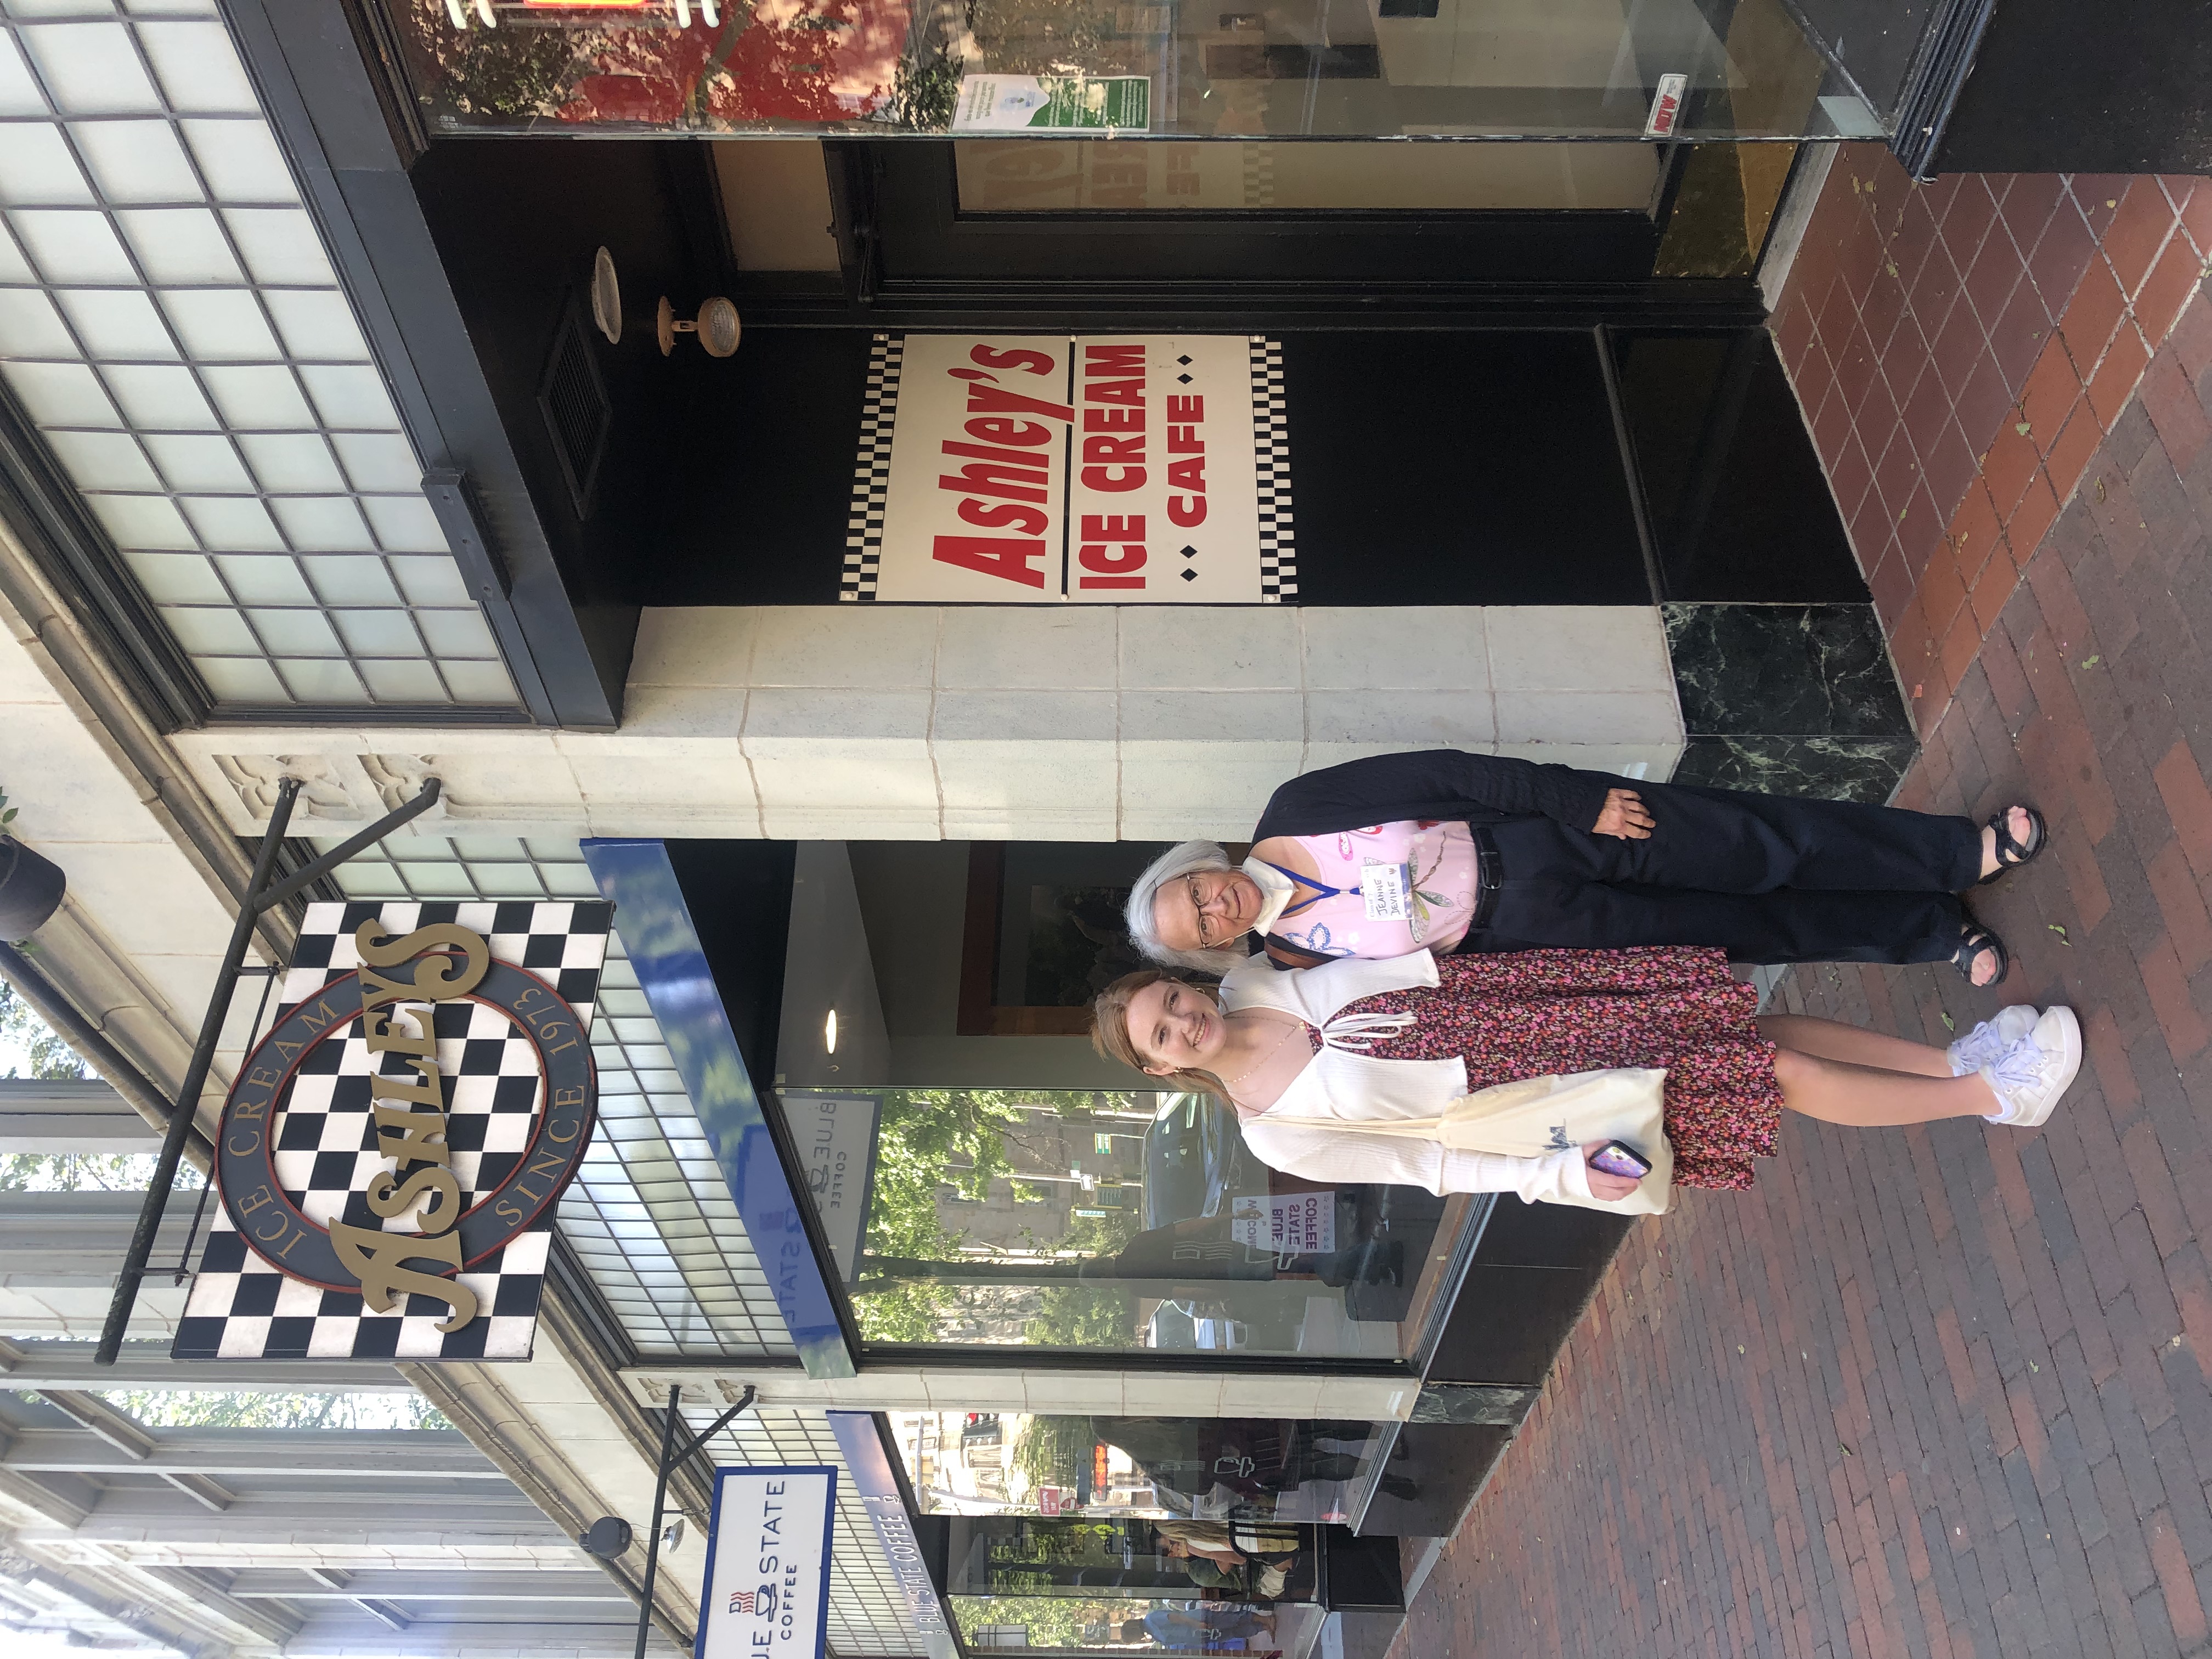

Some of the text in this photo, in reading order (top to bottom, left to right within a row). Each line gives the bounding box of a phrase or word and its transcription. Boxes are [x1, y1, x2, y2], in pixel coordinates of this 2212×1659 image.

[933, 344, 1074, 589] Ashley's
[1078, 344, 1147, 589] ICE CREAM
[1167, 395, 1207, 528] CAFE
[1374, 879, 1387, 916] JEANNE
[1387, 882, 1401, 916] DEVINE
[228, 998, 340, 1259] ICE CREAM
[495, 987, 585, 1226] SINCE 1973
[759, 1481, 785, 1574] STATE
[877, 1515, 940, 1623] BLUE STATE COFFEE
[780, 1565, 797, 1640] COFFEE
